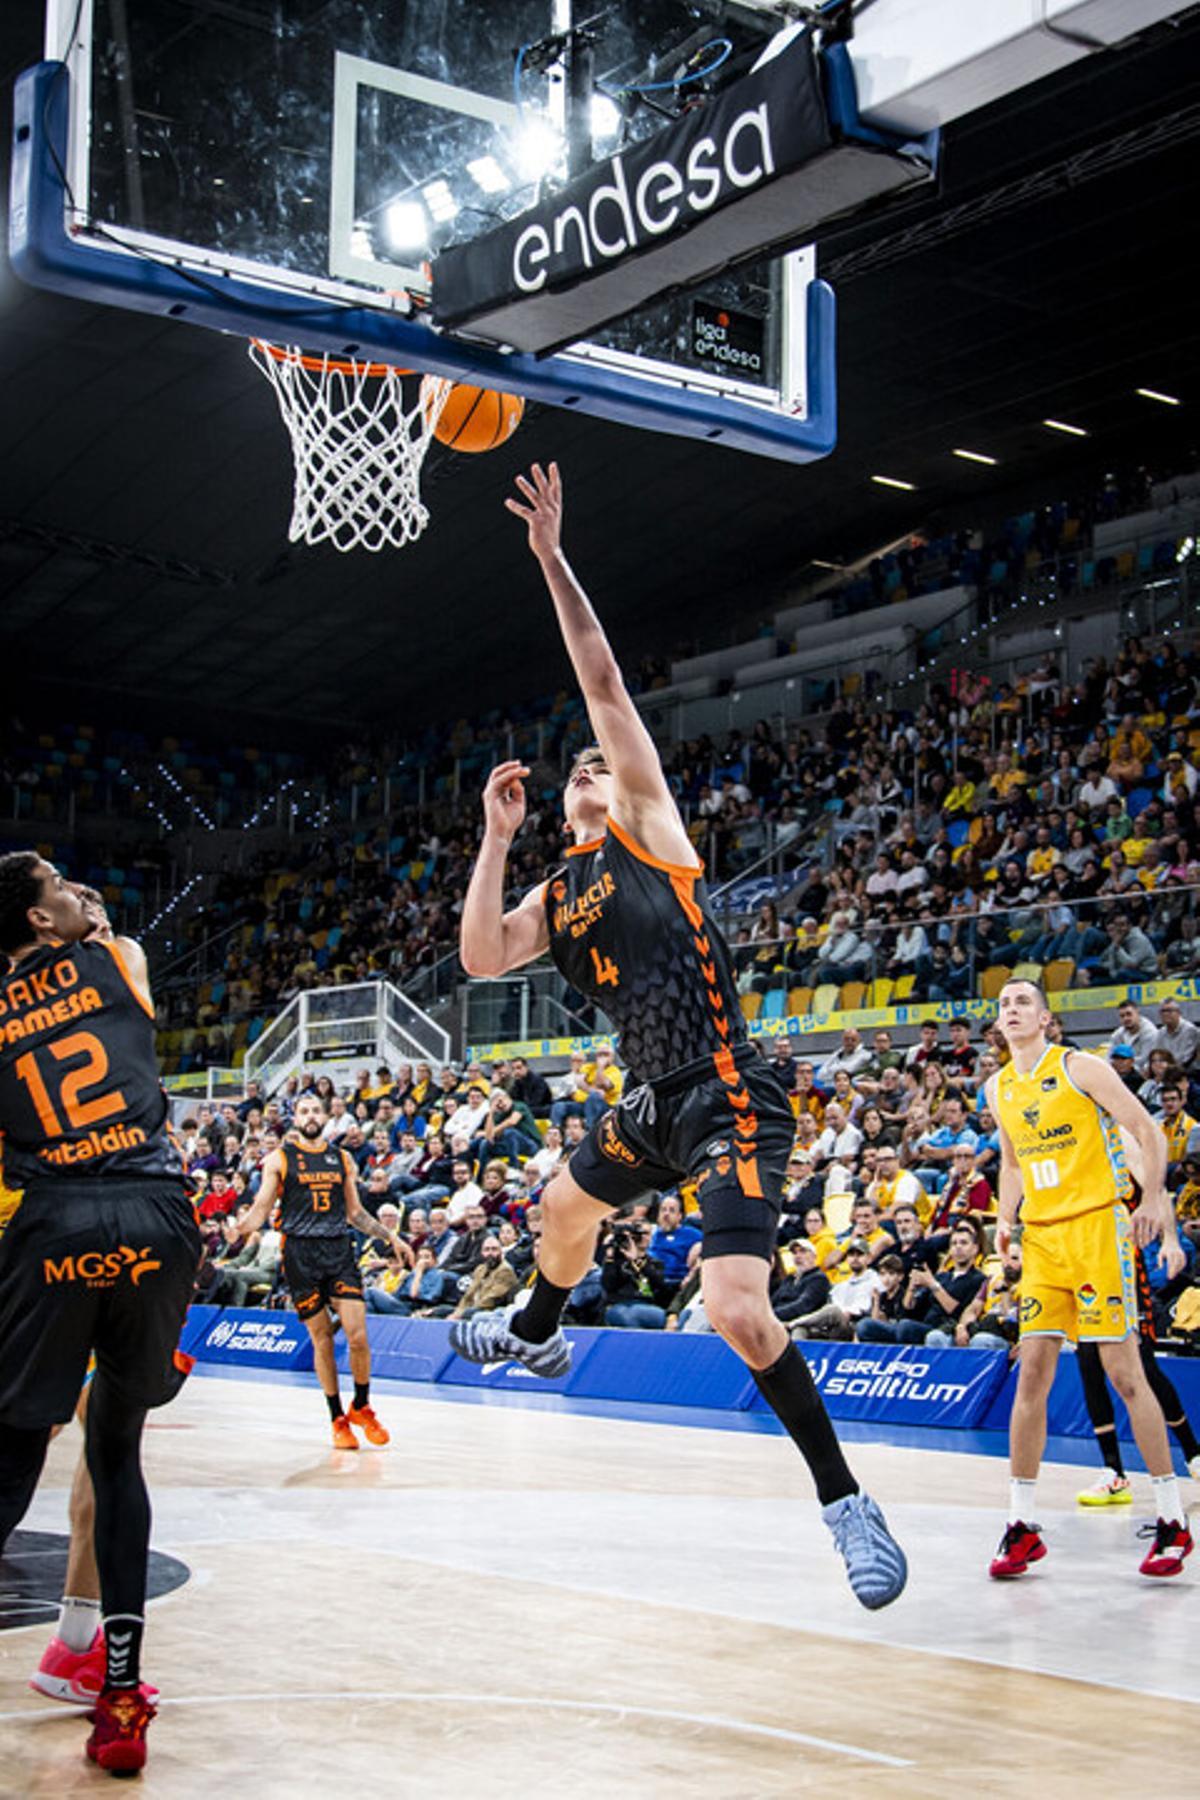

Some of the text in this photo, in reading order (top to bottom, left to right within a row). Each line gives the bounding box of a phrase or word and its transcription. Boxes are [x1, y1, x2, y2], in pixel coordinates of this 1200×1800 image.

[513, 102, 775, 291] endesa
[696, 316, 726, 341] liga
[695, 339, 760, 369] endesa
[590, 946, 619, 987] 4
[16, 1031, 127, 1138] 12
[1030, 1158, 1060, 1190] 10
[312, 1191, 331, 1212] 13
[43, 1252, 121, 1284] MGS
[835, 1358, 930, 1377] GRUPO
